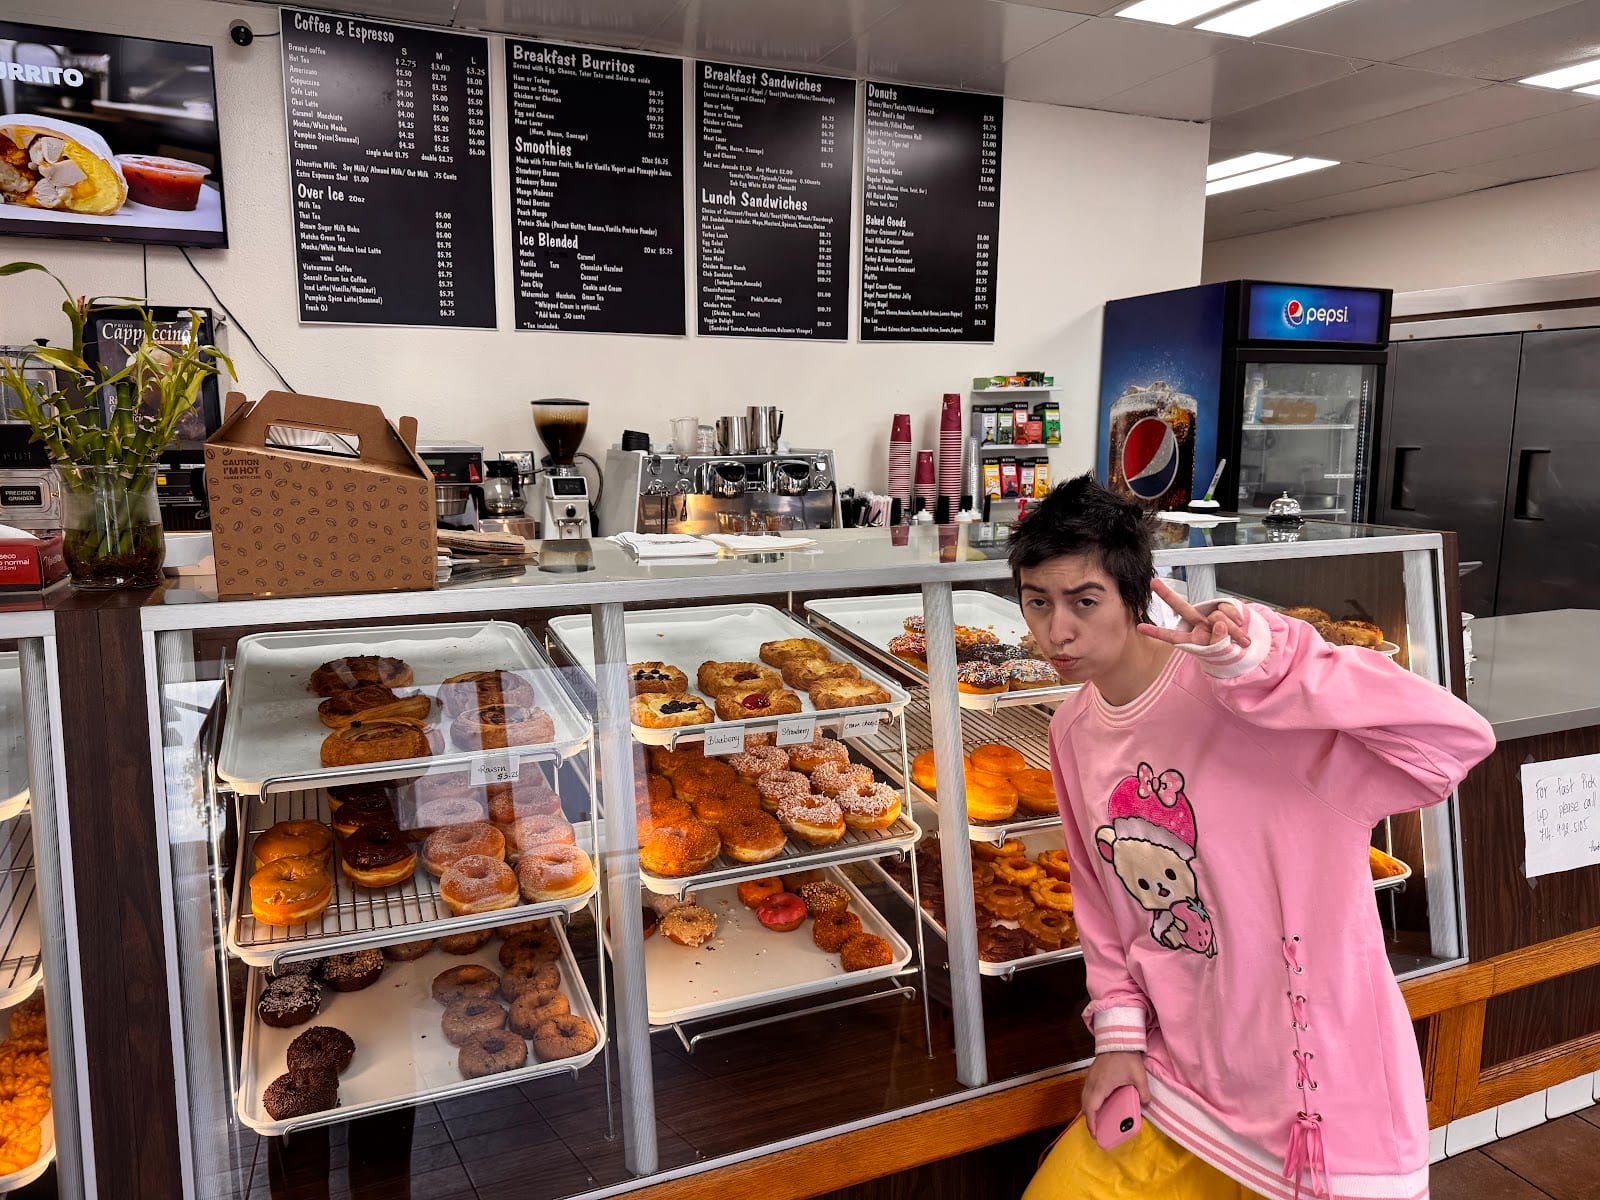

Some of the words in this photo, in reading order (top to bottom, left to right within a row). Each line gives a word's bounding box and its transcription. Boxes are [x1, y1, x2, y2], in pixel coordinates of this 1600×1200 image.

[294, 12, 331, 34] Coffee
[336, 21, 344, 36] &
[348, 21, 394, 44] Espresso
[288, 43, 308, 53] Brewed
[309, 47, 326, 56] coffee
[395, 57, 417, 68] $2.75
[431, 63, 451, 72] $3.00
[467, 67, 486, 76] $3.25
[401, 47, 407, 56] S
[435, 52, 443, 61] M
[513, 45, 576, 67] Breakfast
[582, 54, 635, 74] Burritos
[288, 54, 299, 62] Hot
[300, 56, 310, 64] Tea
[396, 68, 412, 77] $2.50
[431, 73, 447, 82] $2.75
[289, 65, 318, 76] Americano
[396, 79, 412, 88] $2.75
[432, 83, 447, 92] $3.25
[467, 87, 483, 96] $4.00
[704, 65, 757, 85] Breakfast
[760, 72, 822, 93] Sandwiches
[290, 87, 303, 96] Cafe
[305, 88, 318, 98] Latte
[397, 100, 414, 108] $4.00
[432, 104, 449, 113] $5.00
[468, 108, 483, 116] $5.50
[396, 89, 414, 98] $4.00
[431, 94, 448, 103] $5.00
[467, 98, 483, 106] $5.50
[869, 84, 898, 100] Donuts
[291, 98, 303, 107] Chai
[305, 99, 319, 108] Latte
[292, 108, 313, 118] Caramel
[398, 120, 414, 129] $4.25
[293, 119, 329, 131] Mocha/White
[331, 123, 347, 133] Mocha
[398, 131, 415, 139] $4.25
[293, 130, 316, 141] Pumpkin
[398, 141, 415, 150] $4.25
[469, 148, 486, 156] $6.00
[515, 136, 572, 157] Smoothies
[366, 149, 381, 158] single
[382, 150, 393, 159] shot
[395, 151, 409, 159] $1.75
[421, 154, 437, 162] double
[438, 155, 454, 163] $2.75
[296, 170, 311, 178] Extra
[312, 171, 335, 181] Espresso
[335, 173, 348, 181] Shot
[353, 175, 370, 183] $1.00
[342, 162, 353, 172] Soy
[370, 166, 390, 176] Almond
[433, 171, 442, 179] .75
[298, 183, 324, 200] Over
[328, 186, 345, 201] Ice
[702, 189, 736, 206] Lunch
[741, 191, 808, 211] Sandwiches
[312, 202, 321, 210] Tea
[311, 212, 320, 220] Tea
[435, 212, 451, 220] $5.00
[866, 215, 885, 226] Baked
[887, 216, 906, 227] Goods
[519, 231, 535, 246] Ice
[538, 232, 579, 249] Blended
[577, 253, 595, 261] Caramel
[335, 265, 352, 273] Coffee
[1306, 306, 1347, 325] pepsi
[102, 323, 191, 345] Cappccino
[480, 765, 506, 773] Raisin
[1536, 779, 1548, 800] For
[1556, 777, 1574, 796] fast
[1581, 773, 1597, 790] Pick
[1559, 801, 1579, 818] please
[1584, 792, 1596, 809] call
